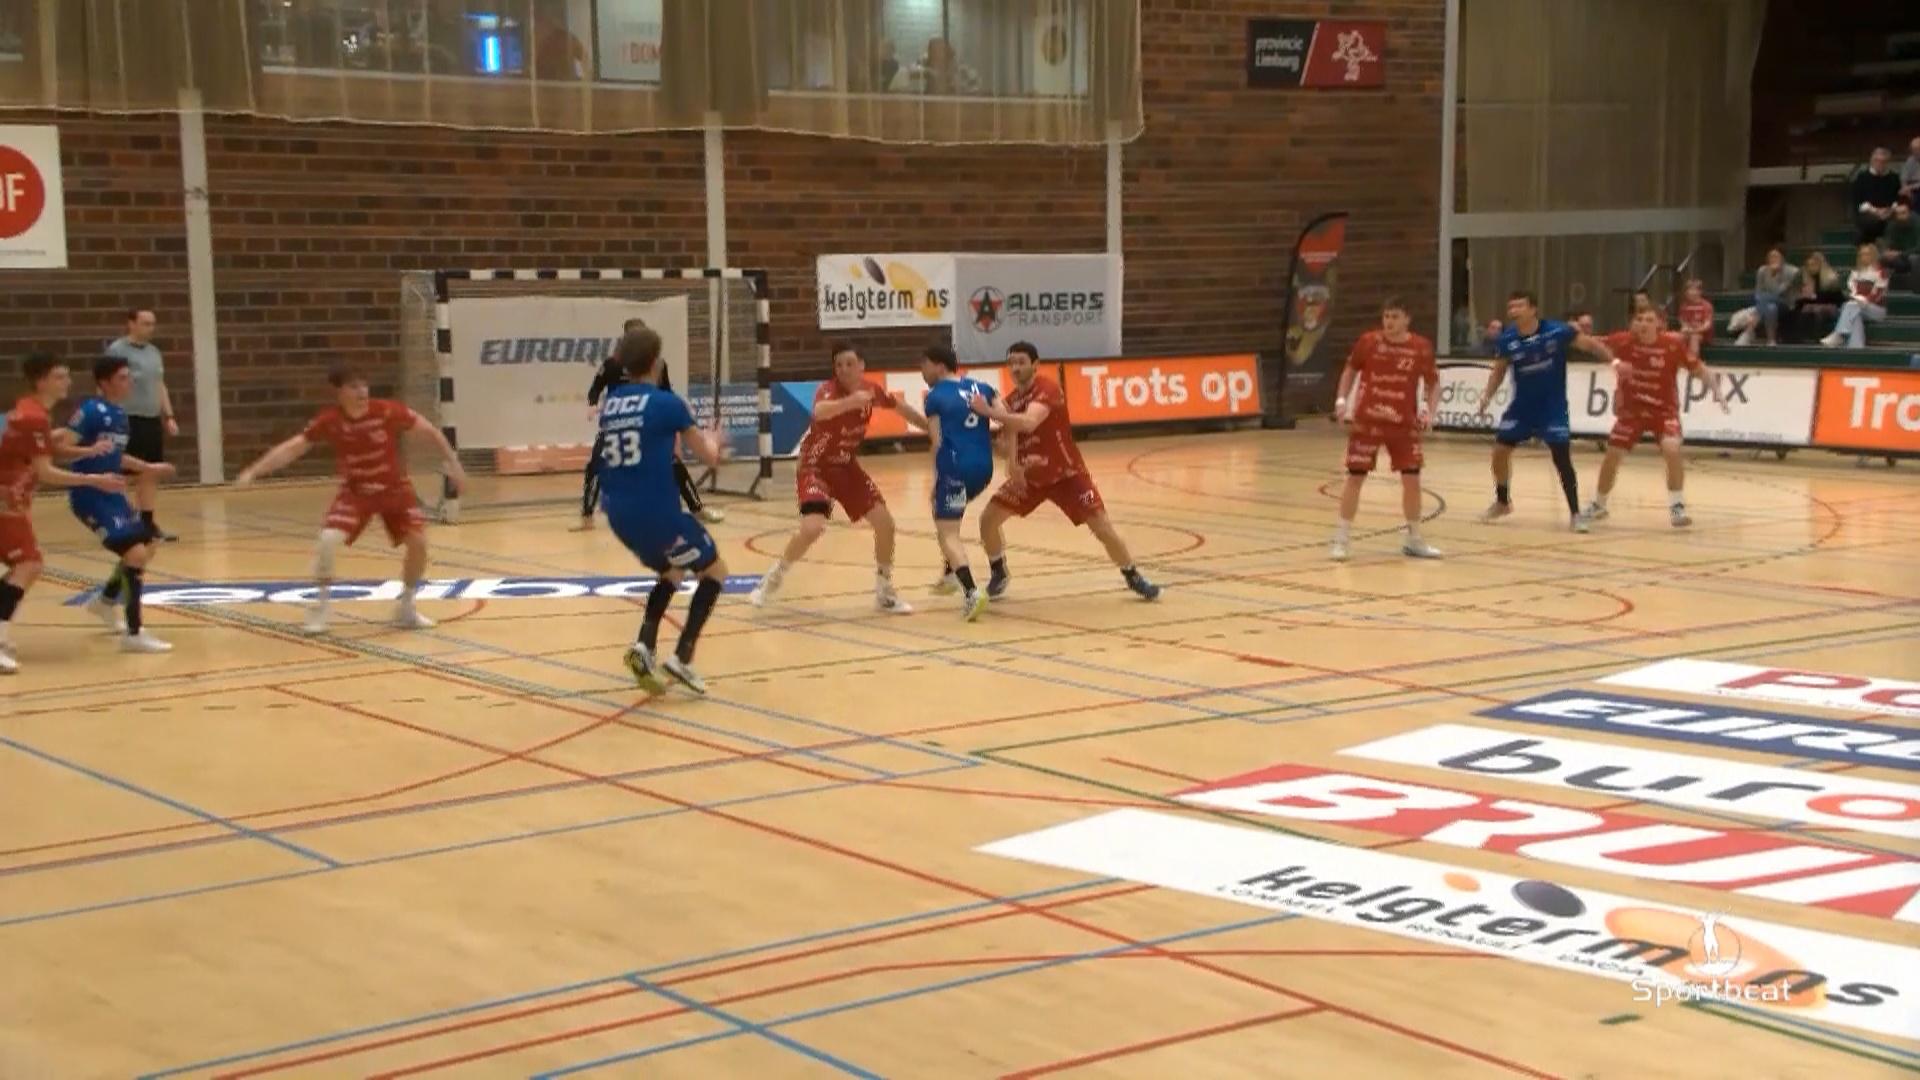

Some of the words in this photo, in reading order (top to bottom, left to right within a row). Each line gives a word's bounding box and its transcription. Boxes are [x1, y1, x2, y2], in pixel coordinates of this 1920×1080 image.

[0, 172, 25, 212] F
[1007, 292, 1104, 311] ALDERS
[1007, 309, 1104, 328] TRANSPORT
[1081, 366, 1188, 409] Trots
[1201, 370, 1253, 413] op
[601, 430, 642, 468] 33
